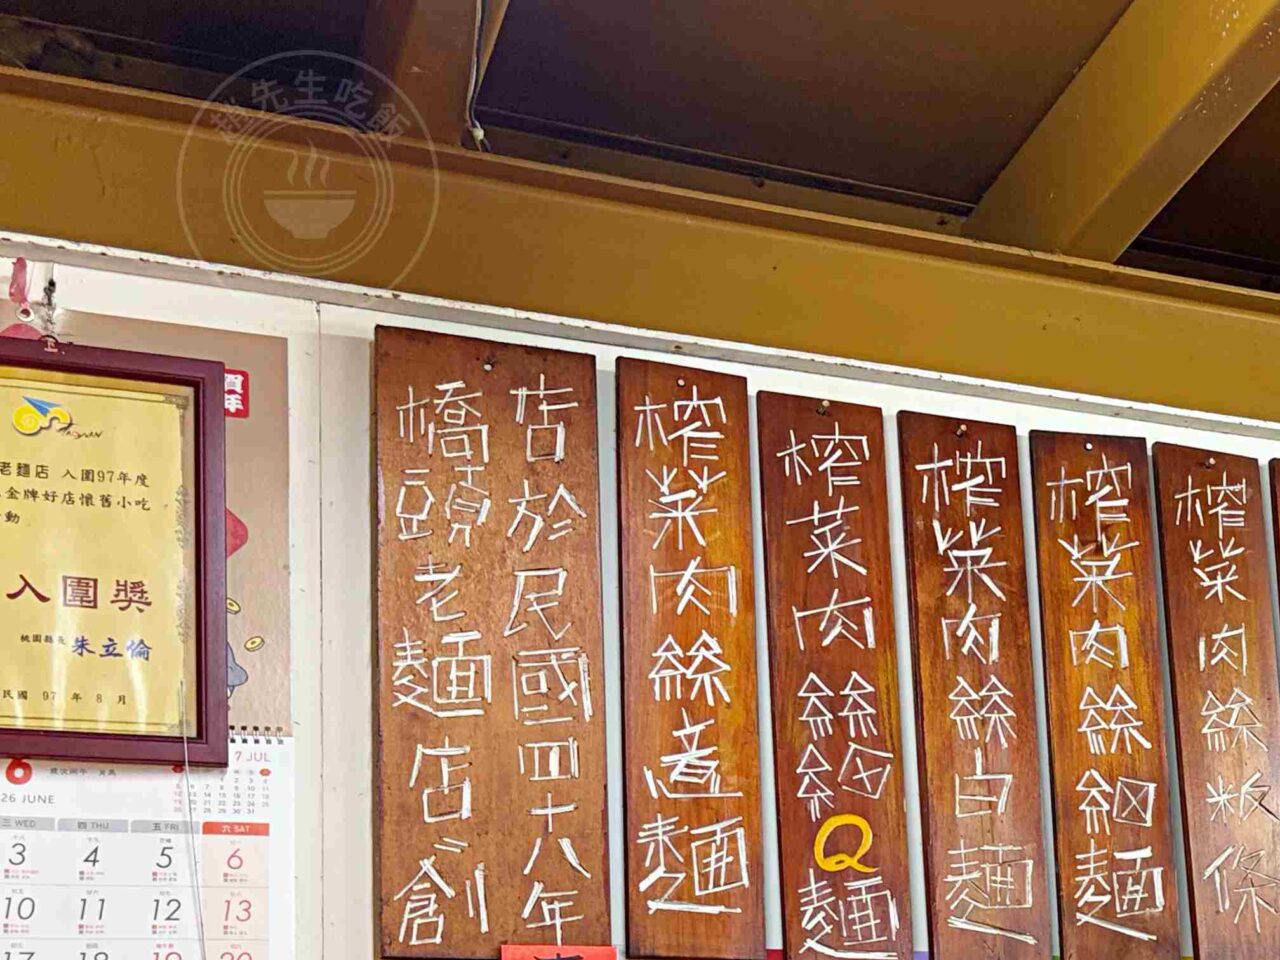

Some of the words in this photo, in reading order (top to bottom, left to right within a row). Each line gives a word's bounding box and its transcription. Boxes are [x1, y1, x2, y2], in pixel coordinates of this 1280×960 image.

[6, 574, 152, 613] 入圍獎
[72, 636, 152, 661] 朱立倫
[915, 441, 1039, 944] 榨菜肉絲白麵
[235, 751, 242, 762] 7
[246, 751, 271, 763] JUL
[6, 757, 33, 785] 6
[22, 794, 55, 805] JUNE
[15, 820, 36, 828] WED
[91, 822, 109, 830] THU
[233, 825, 250, 833] SAT
[8, 843, 26, 865] 3
[83, 846, 100, 867] 4
[156, 846, 174, 869] 5
[227, 848, 243, 870] 6
[4, 897, 36, 920] 10
[80, 898, 106, 920] 11
[152, 898, 182, 921] 12
[223, 900, 252, 922] 13
